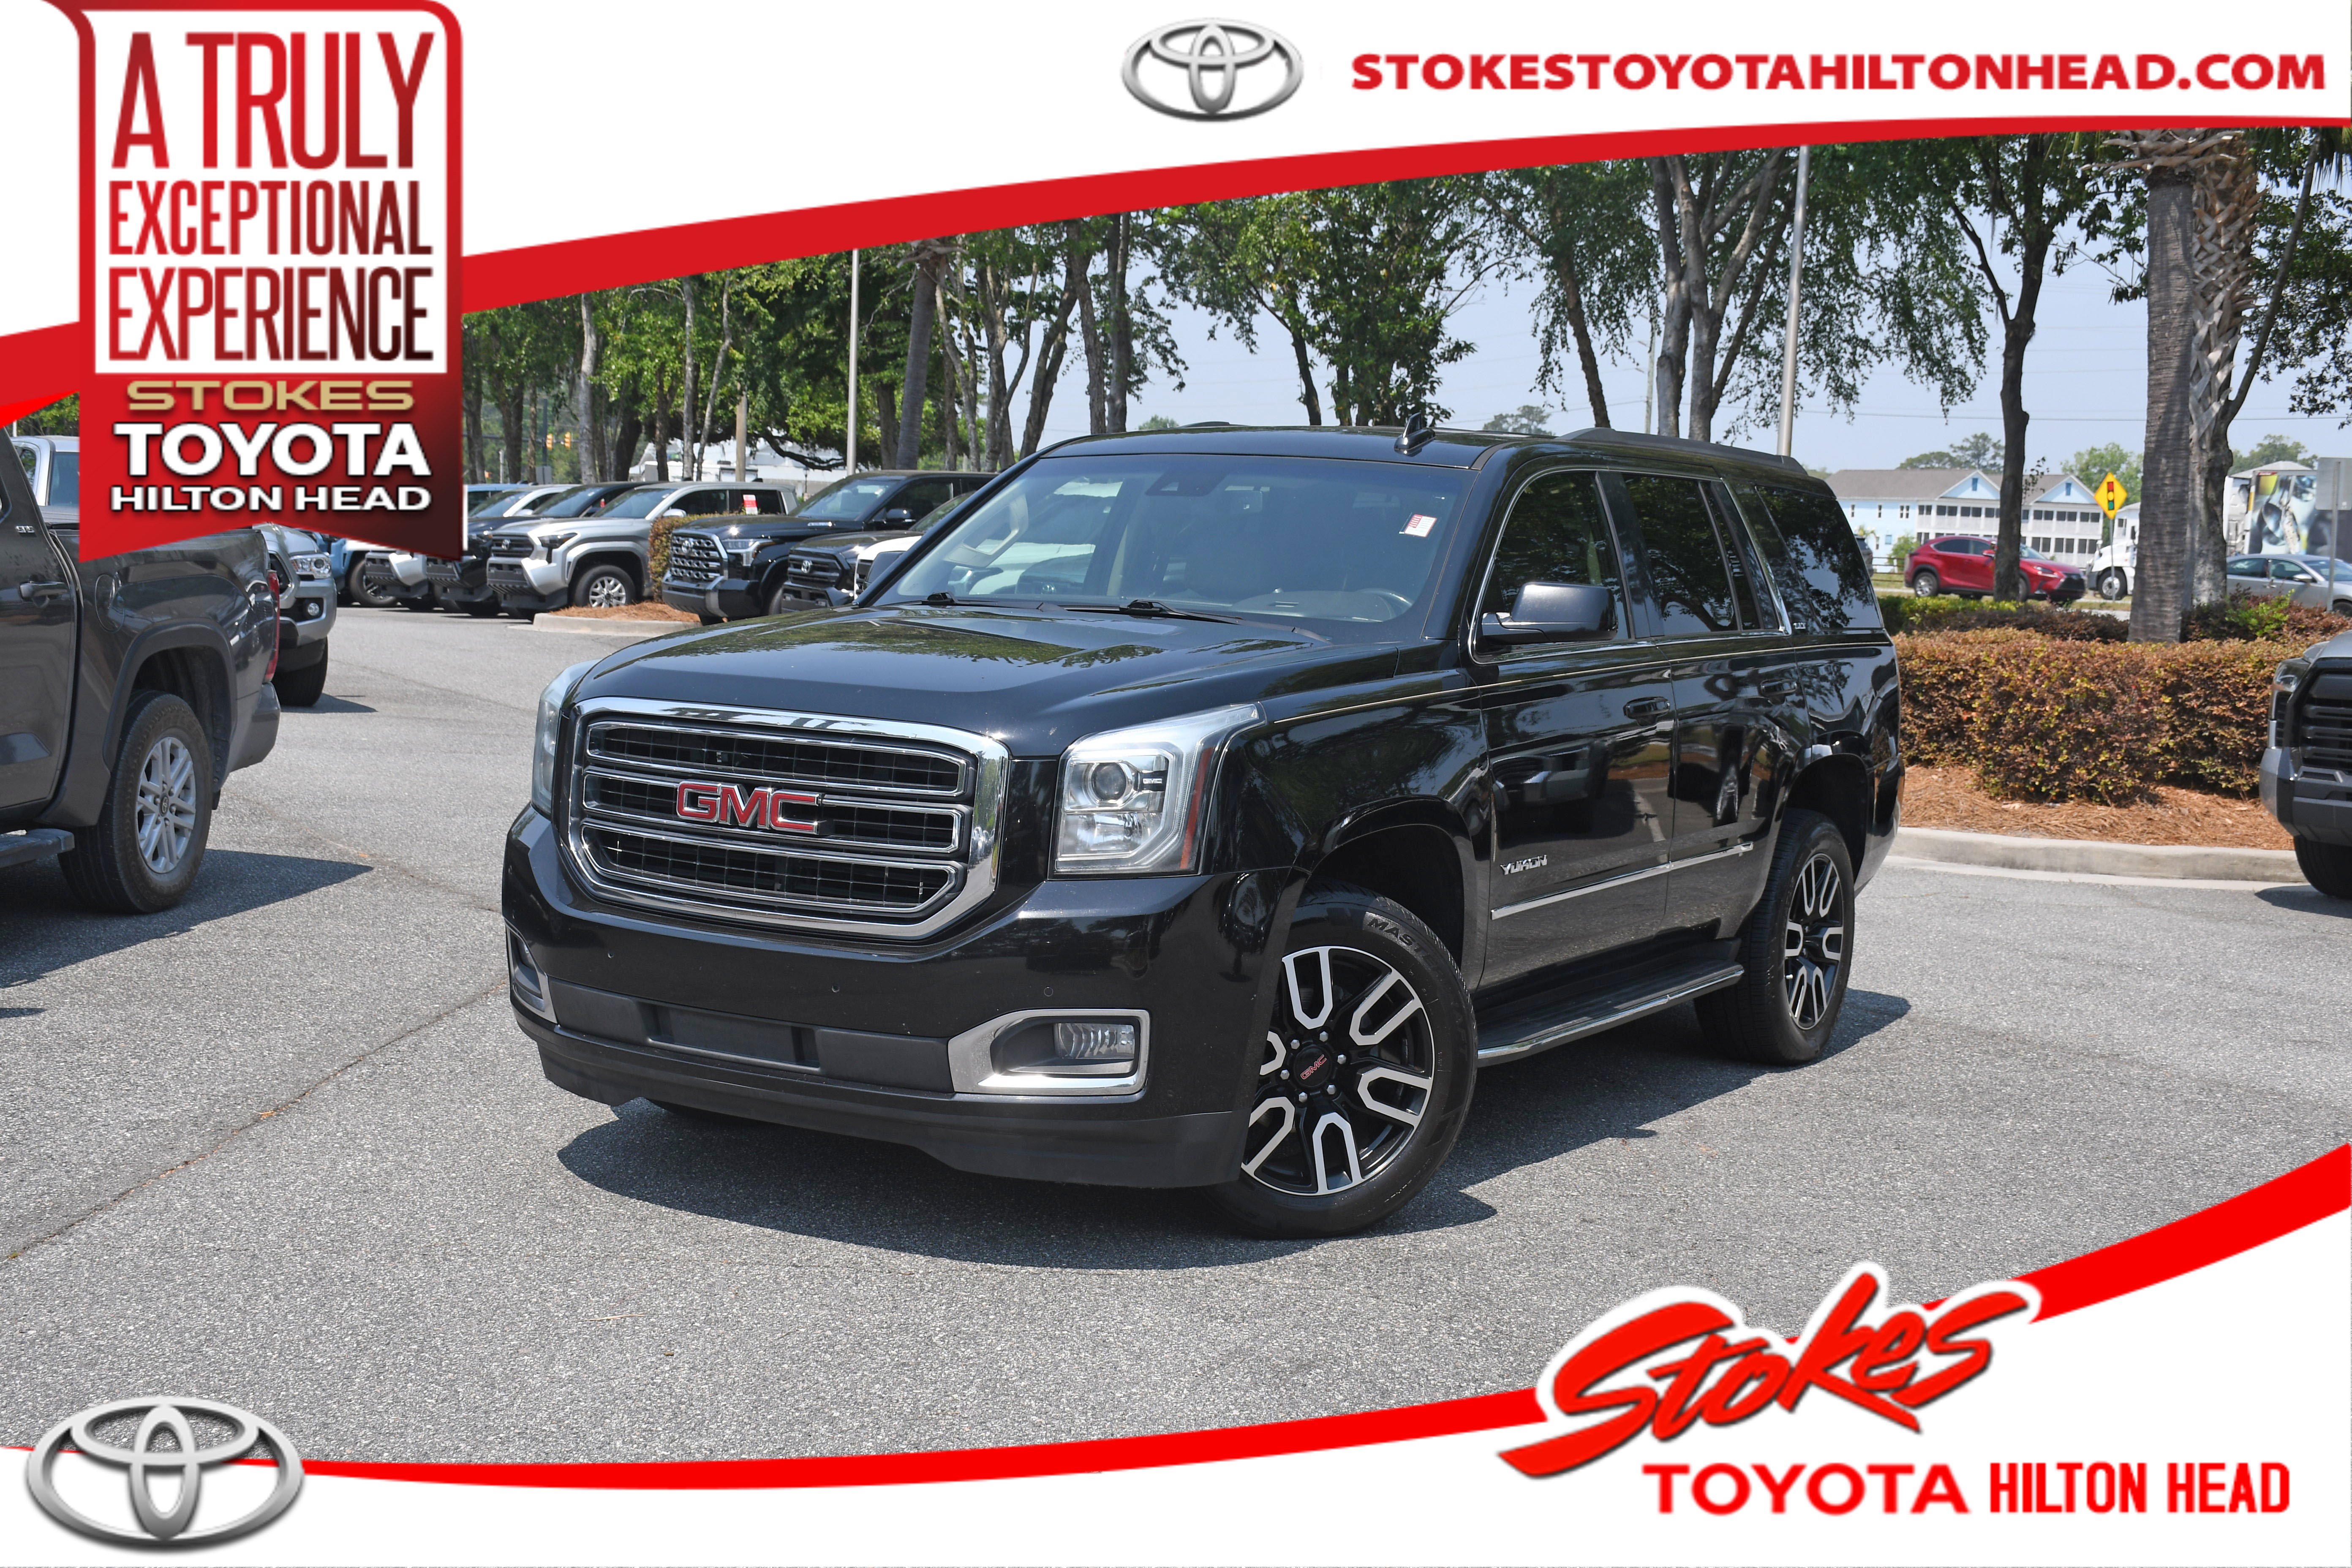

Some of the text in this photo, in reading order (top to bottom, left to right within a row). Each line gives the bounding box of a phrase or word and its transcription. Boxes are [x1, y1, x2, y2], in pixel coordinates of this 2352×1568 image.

[676, 781, 820, 835] GMC
[1500, 854, 1548, 875] YUKON
[1301, 1054, 1327, 1079] GMC
